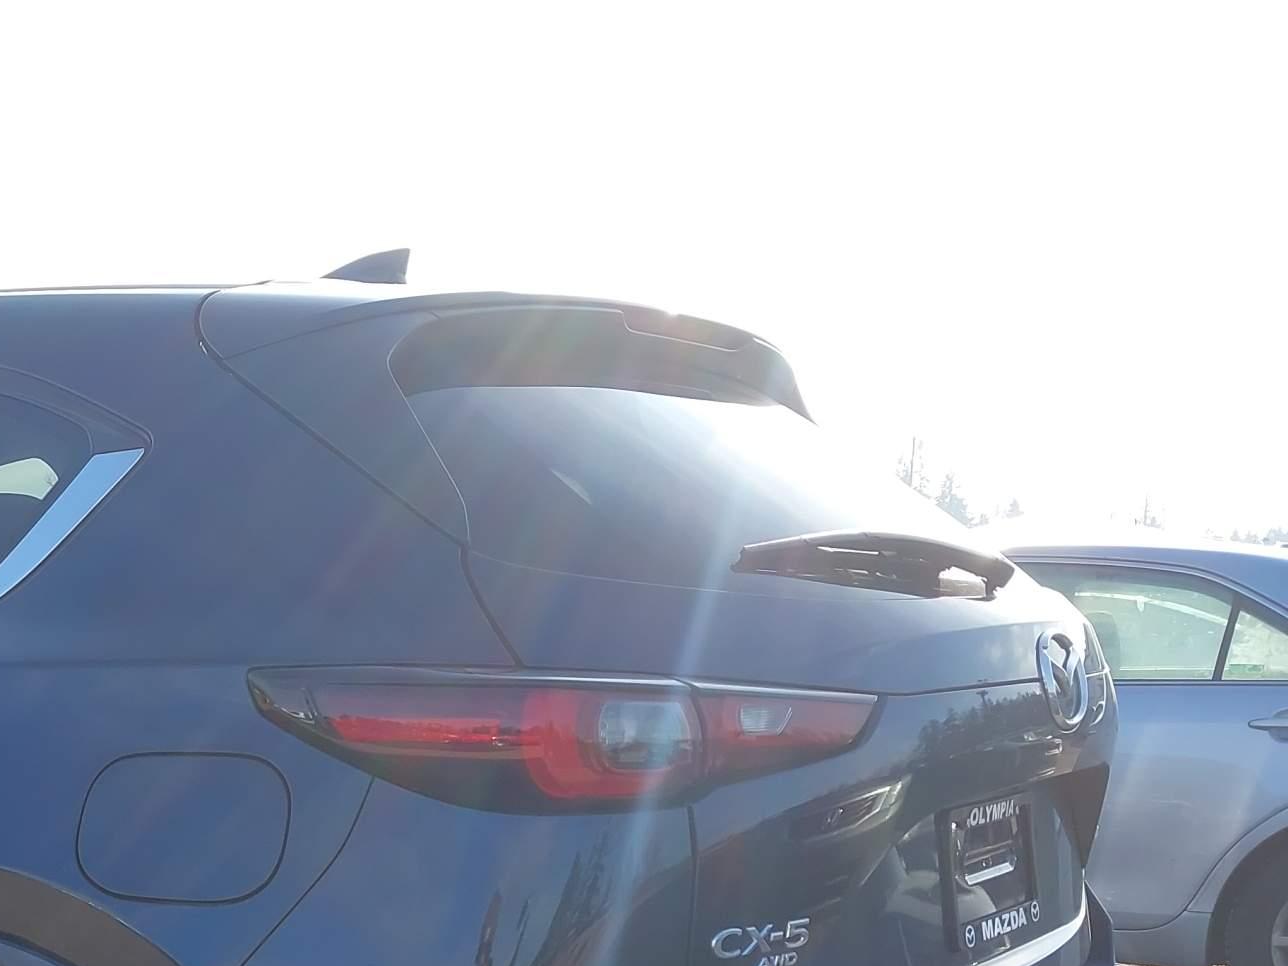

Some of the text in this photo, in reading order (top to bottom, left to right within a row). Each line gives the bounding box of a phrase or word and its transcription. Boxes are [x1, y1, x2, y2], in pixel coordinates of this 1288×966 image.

[970, 799, 1014, 826] OLYMPIA
[712, 918, 810, 958] CX-5
[981, 907, 1028, 941] MAZDA
